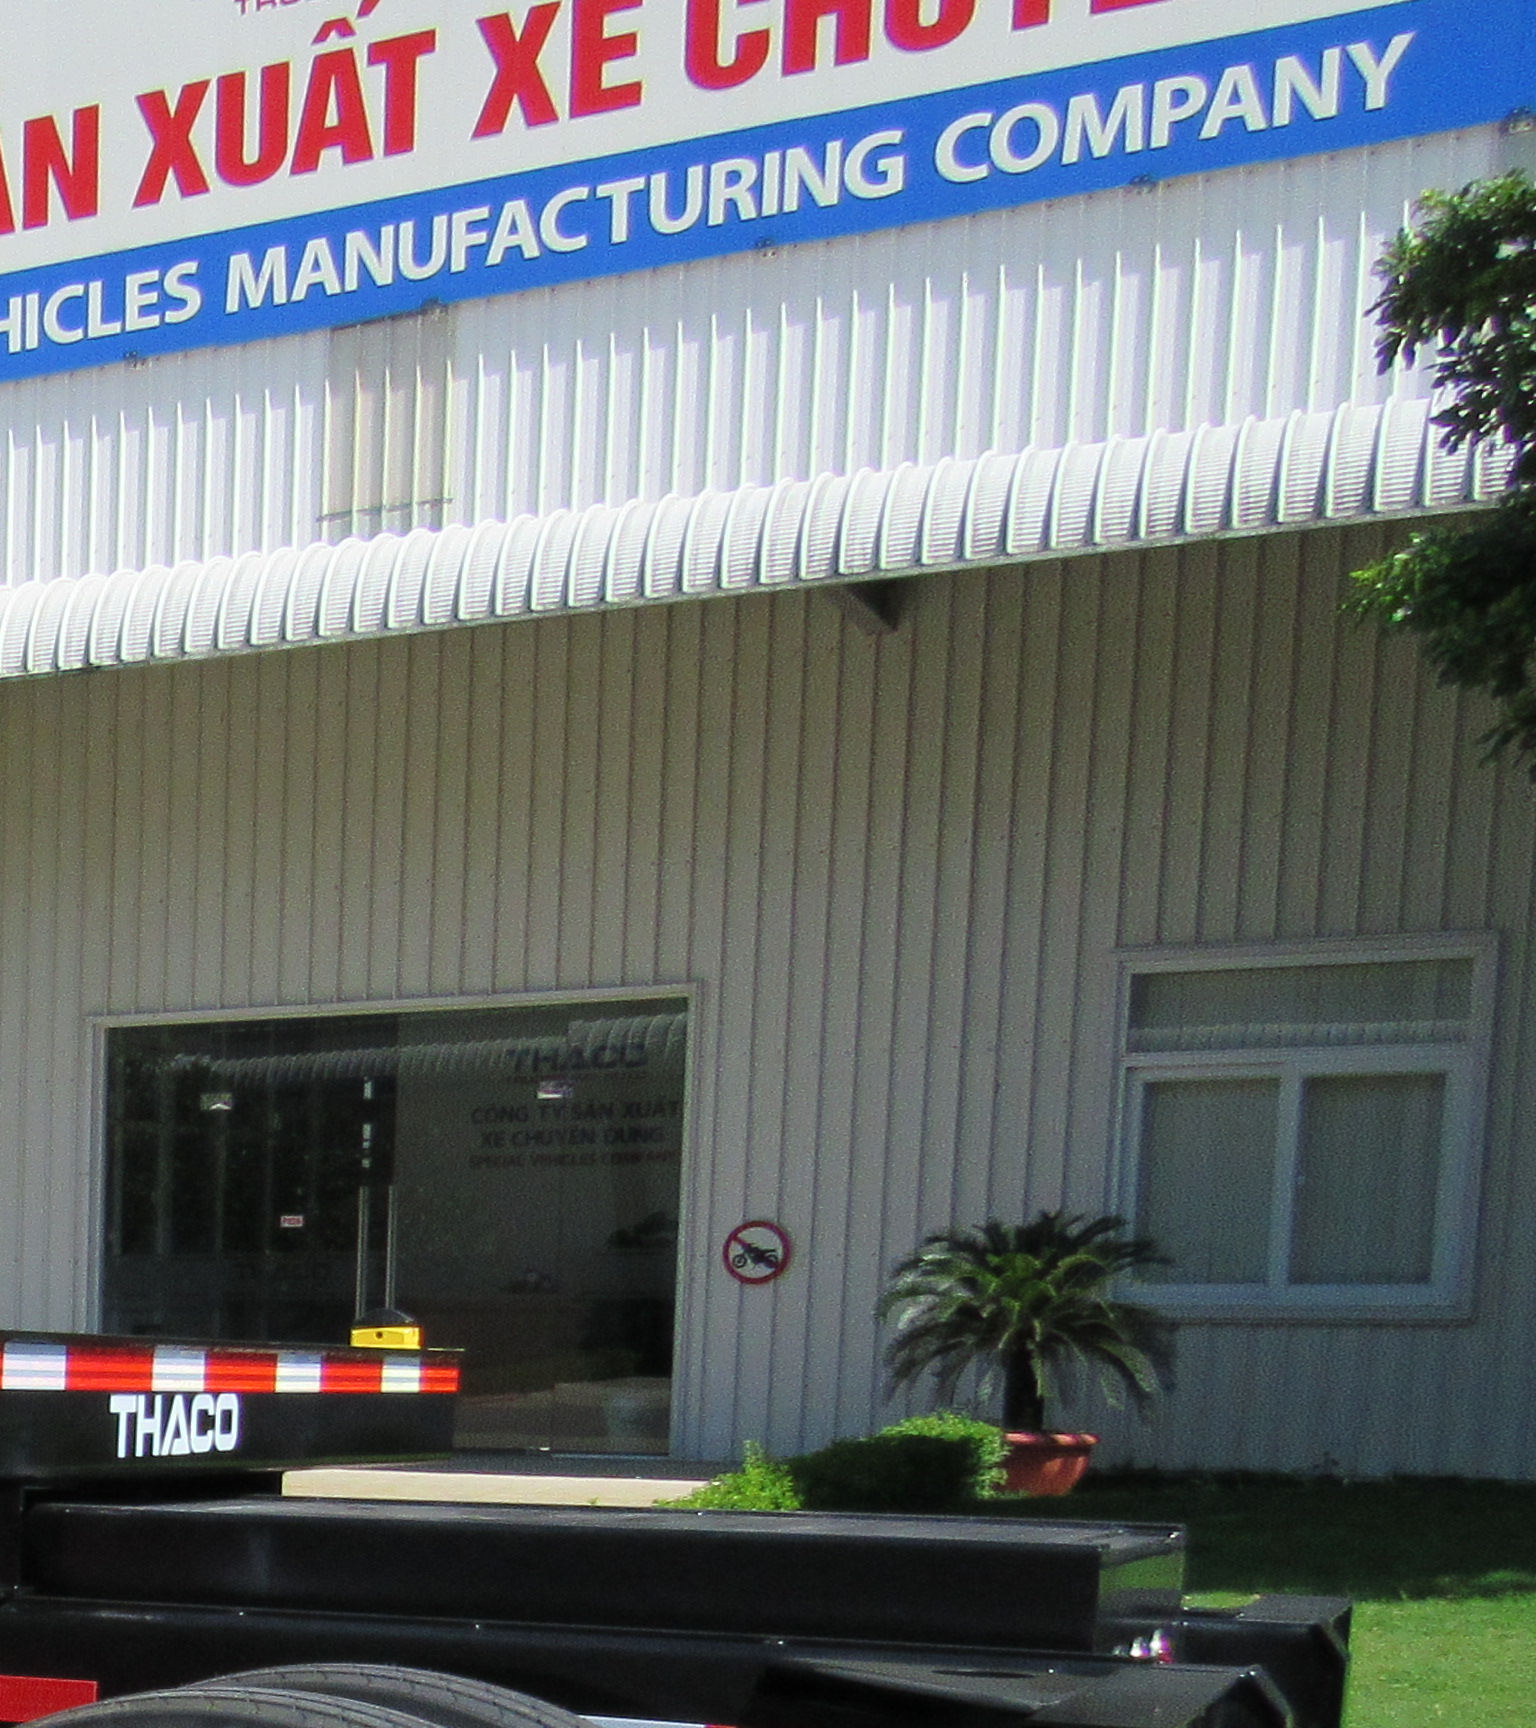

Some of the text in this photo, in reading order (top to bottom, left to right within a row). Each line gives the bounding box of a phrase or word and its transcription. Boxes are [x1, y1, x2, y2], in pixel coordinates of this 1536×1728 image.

[134, 0, 437, 207] XUẤT
[473, 0, 644, 138] XE
[226, 130, 907, 314] MANUFACTURING
[935, 33, 1415, 183] COMPANY
[109, 1393, 239, 1459] THACO
